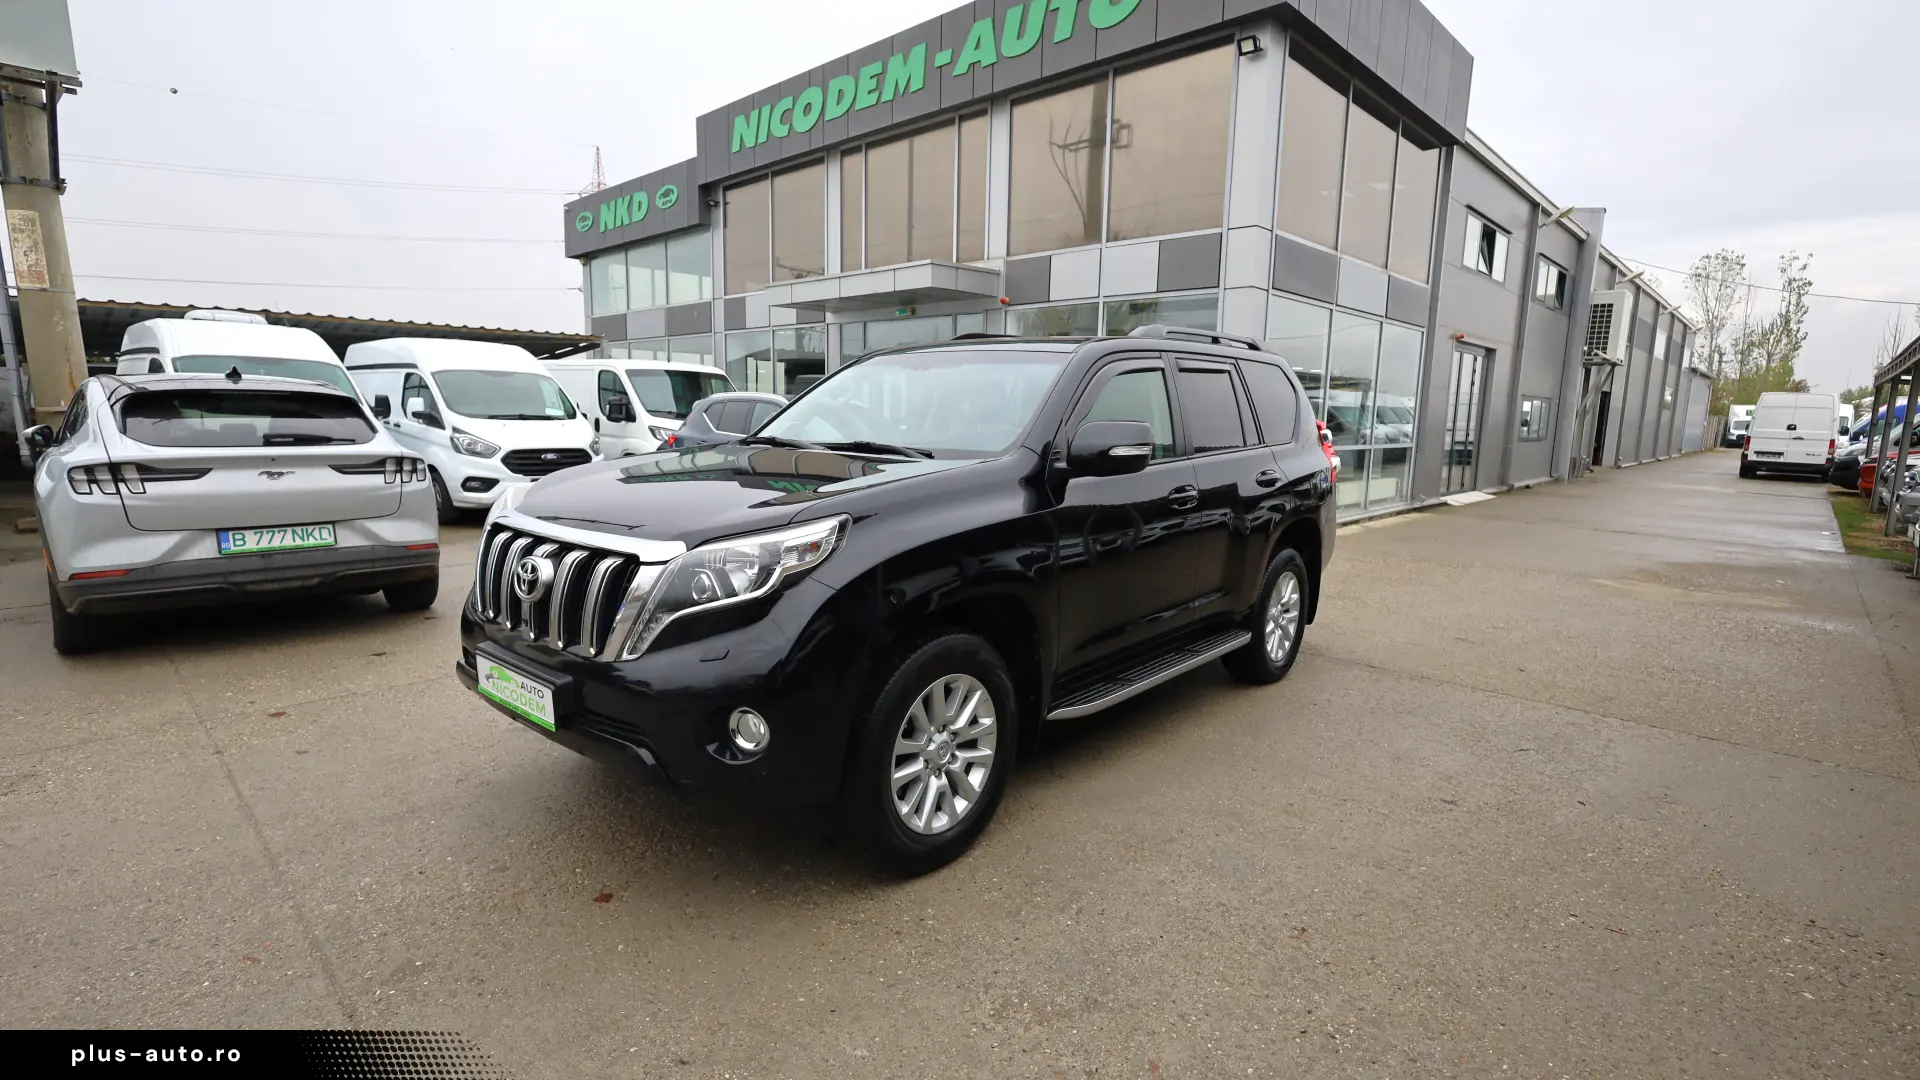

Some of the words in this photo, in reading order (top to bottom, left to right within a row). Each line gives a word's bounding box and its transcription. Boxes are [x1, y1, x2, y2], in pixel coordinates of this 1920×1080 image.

[600, 191, 649, 233] NKD
[232, 532, 247, 548] B
[254, 529, 288, 546] 777
[291, 526, 332, 543] NKD
[492, 679, 546, 716] NICODEM
[520, 681, 545, 699] AUTO
